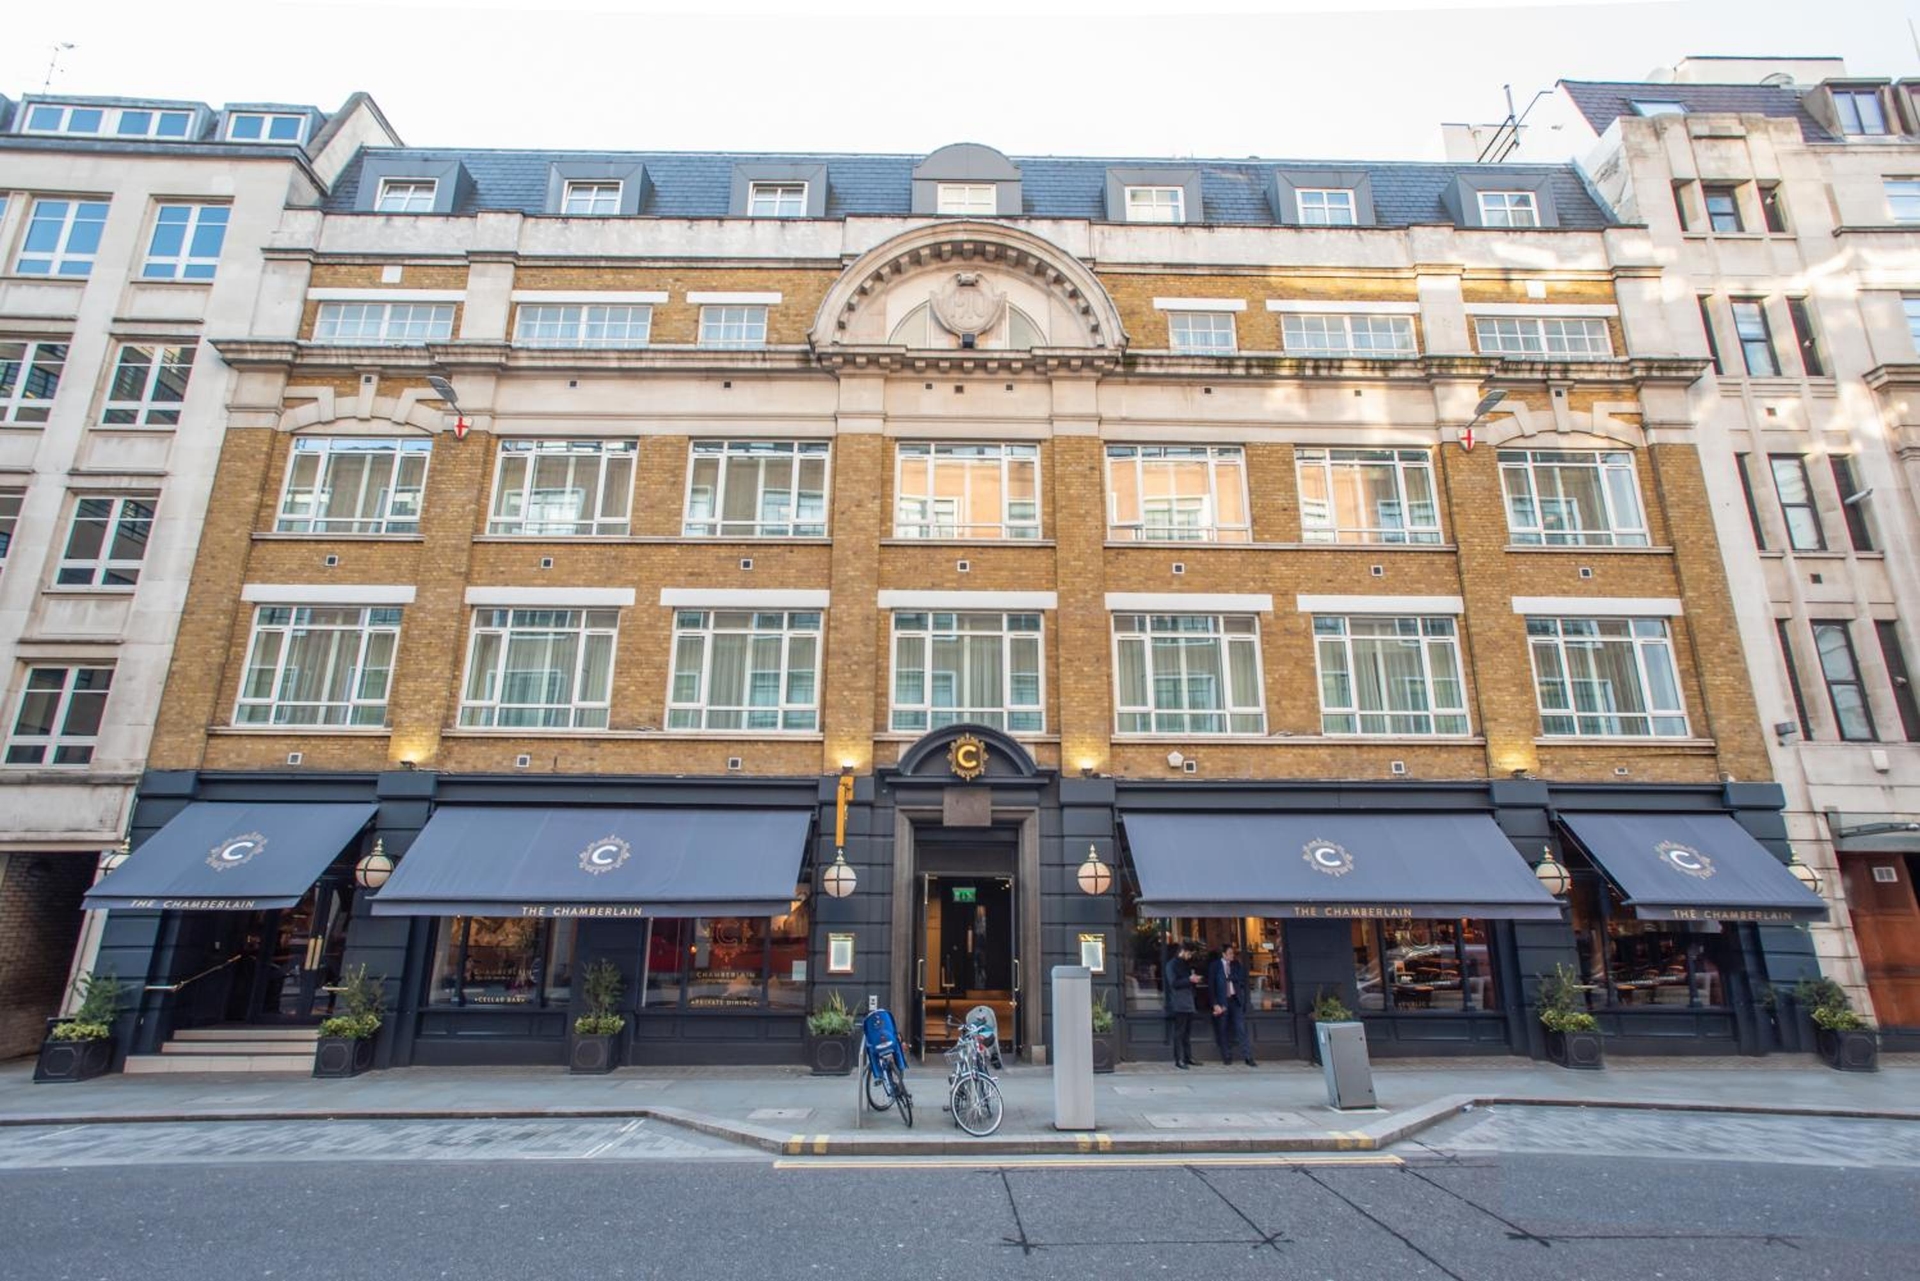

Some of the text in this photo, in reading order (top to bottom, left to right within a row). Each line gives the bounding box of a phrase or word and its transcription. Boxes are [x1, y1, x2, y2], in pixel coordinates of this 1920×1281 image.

[957, 745, 977, 768] C
[222, 841, 254, 861] C
[592, 845, 618, 865] C
[1315, 847, 1341, 866] C
[1669, 850, 1702, 869] C
[130, 900, 255, 909] THE CHAMBERLAIN
[522, 906, 642, 916] THE CHAMBERLAIN
[1294, 907, 1412, 917] THE CHAMBERLAIN
[1671, 909, 1792, 920] THE CHAMBERLAIN
